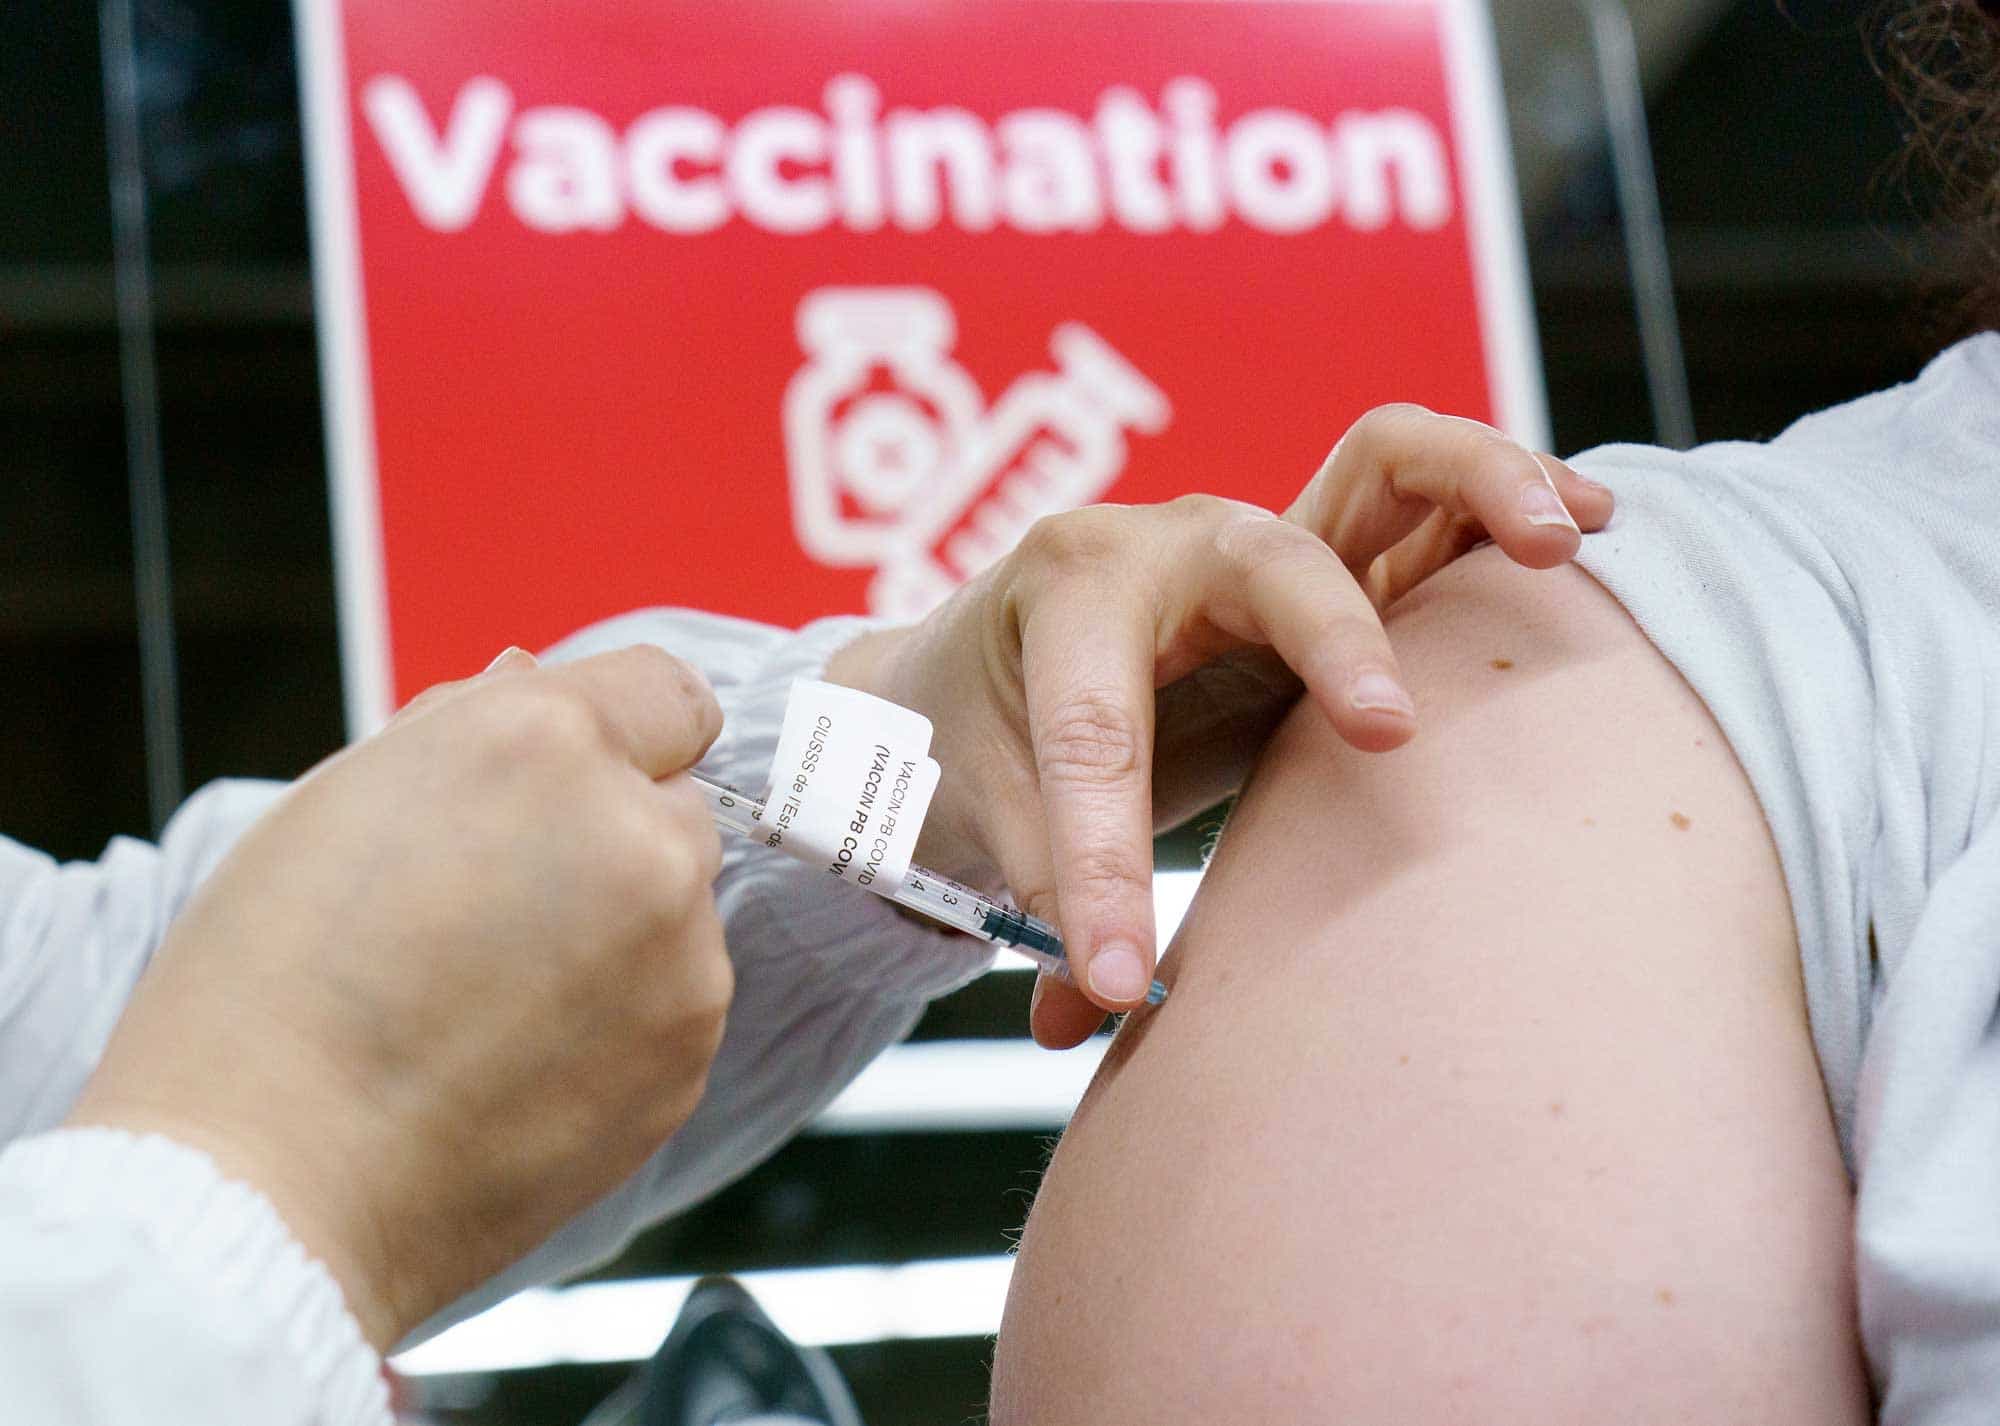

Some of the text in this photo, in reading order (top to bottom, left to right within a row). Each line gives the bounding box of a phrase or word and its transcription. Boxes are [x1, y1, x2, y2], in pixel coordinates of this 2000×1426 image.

[362, 73, 1452, 234] Vaccination
[801, 715, 832, 773] CIUSSS
[792, 774, 808, 793] de
[860, 744, 890, 809] (VACCIN
[850, 810, 868, 835] PB
[857, 761, 916, 886] VACCIN PB COVID
